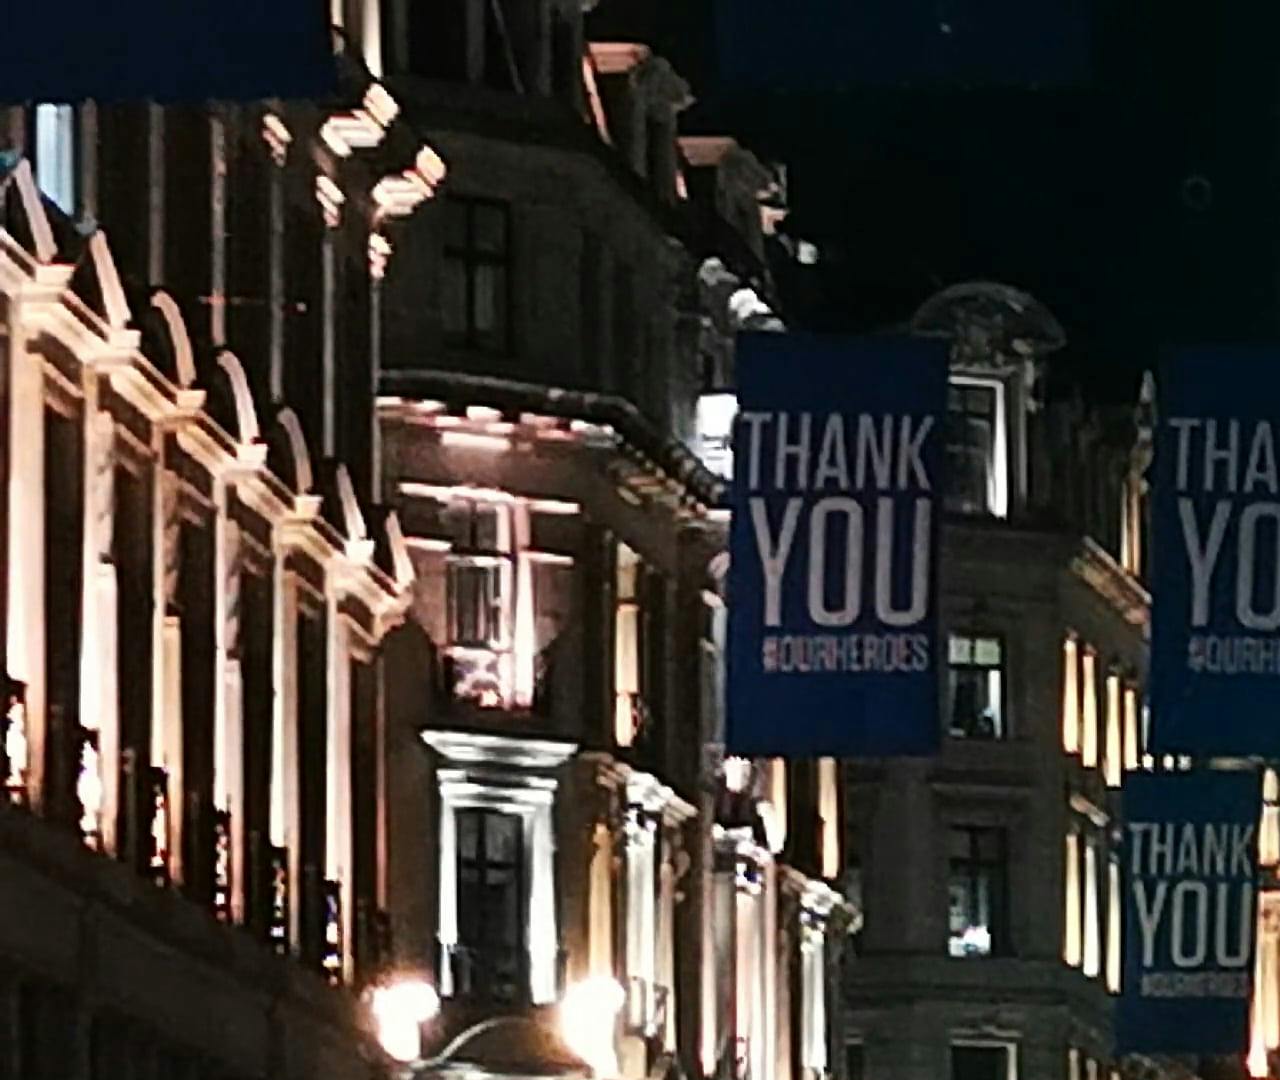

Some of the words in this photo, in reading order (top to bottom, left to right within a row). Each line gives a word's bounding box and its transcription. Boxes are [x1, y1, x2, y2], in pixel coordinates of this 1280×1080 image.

[742, 411, 934, 492] THANK
[747, 497, 936, 628] YOU
[763, 634, 929, 673] #OURHEROES
[1128, 822, 1254, 876] THANK
[1132, 880, 1252, 969] YOU
